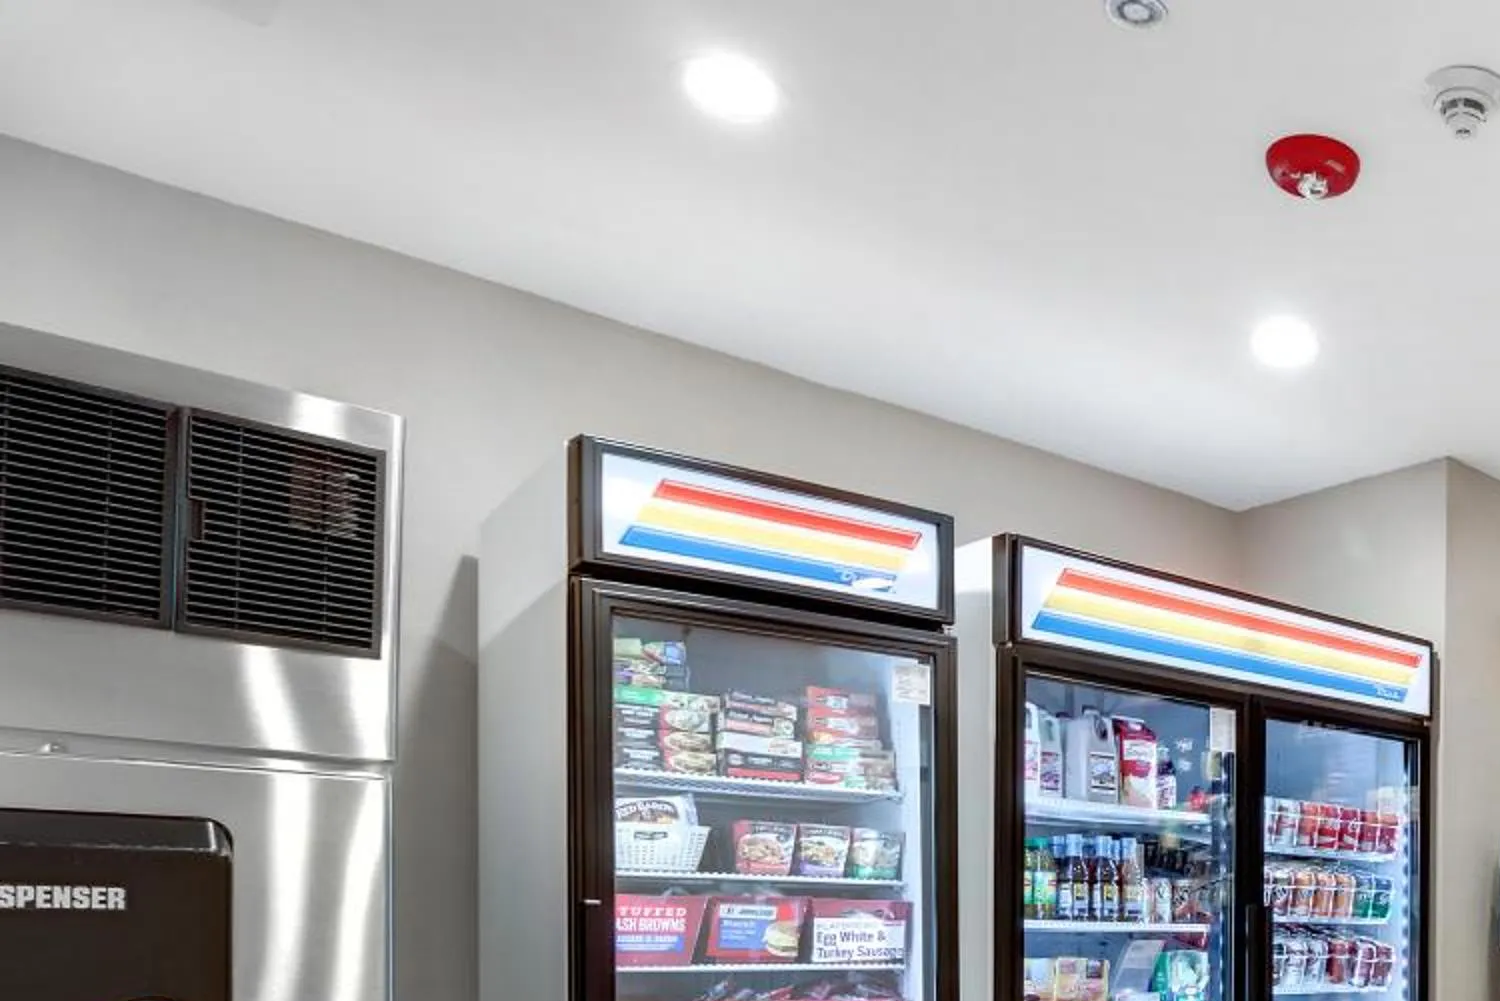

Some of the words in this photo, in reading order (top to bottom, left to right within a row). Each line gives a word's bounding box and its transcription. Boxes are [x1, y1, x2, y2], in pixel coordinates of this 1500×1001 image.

[0, 885, 126, 910] SPENSER
[617, 906, 687, 917] TUFFED
[616, 918, 637, 933] ASH
[816, 931, 837, 947] Egg
[839, 930, 874, 943] White
[876, 930, 887, 943] &
[816, 947, 855, 960] Turkey
